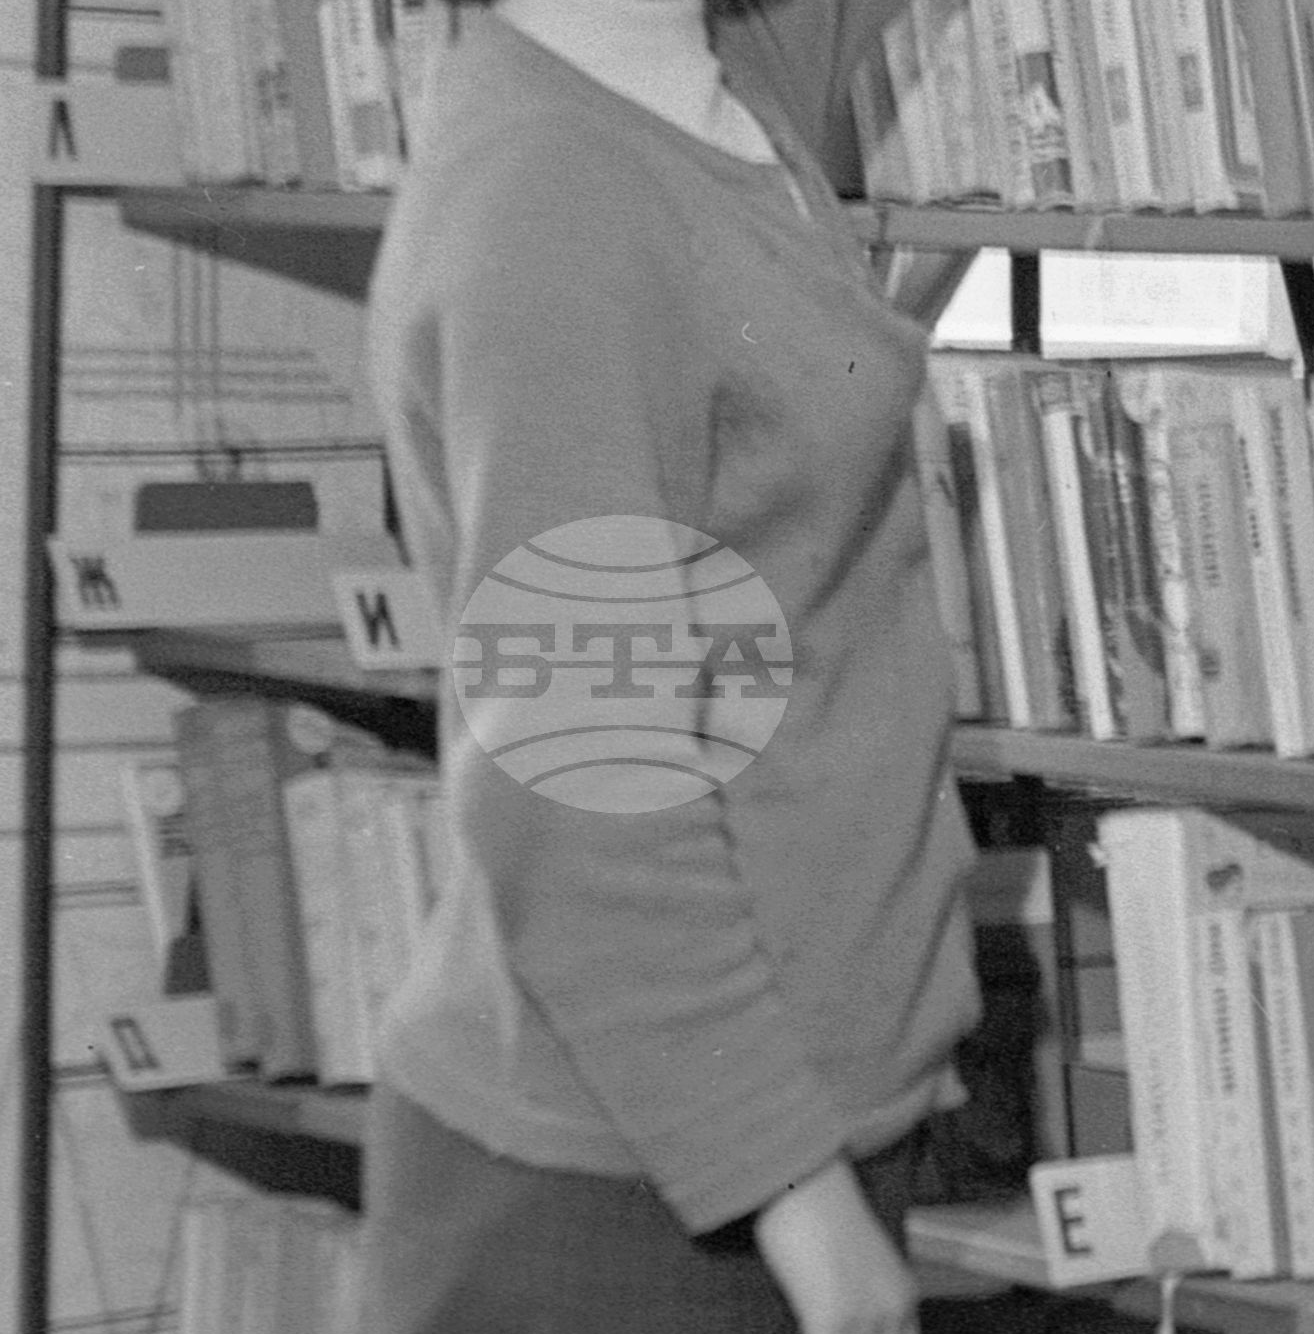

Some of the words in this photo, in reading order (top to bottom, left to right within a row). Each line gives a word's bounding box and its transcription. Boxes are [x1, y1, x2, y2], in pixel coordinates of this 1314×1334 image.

[69, 555, 121, 611] Ж
[353, 590, 401, 651] И
[1054, 1186, 1093, 1257] Е
